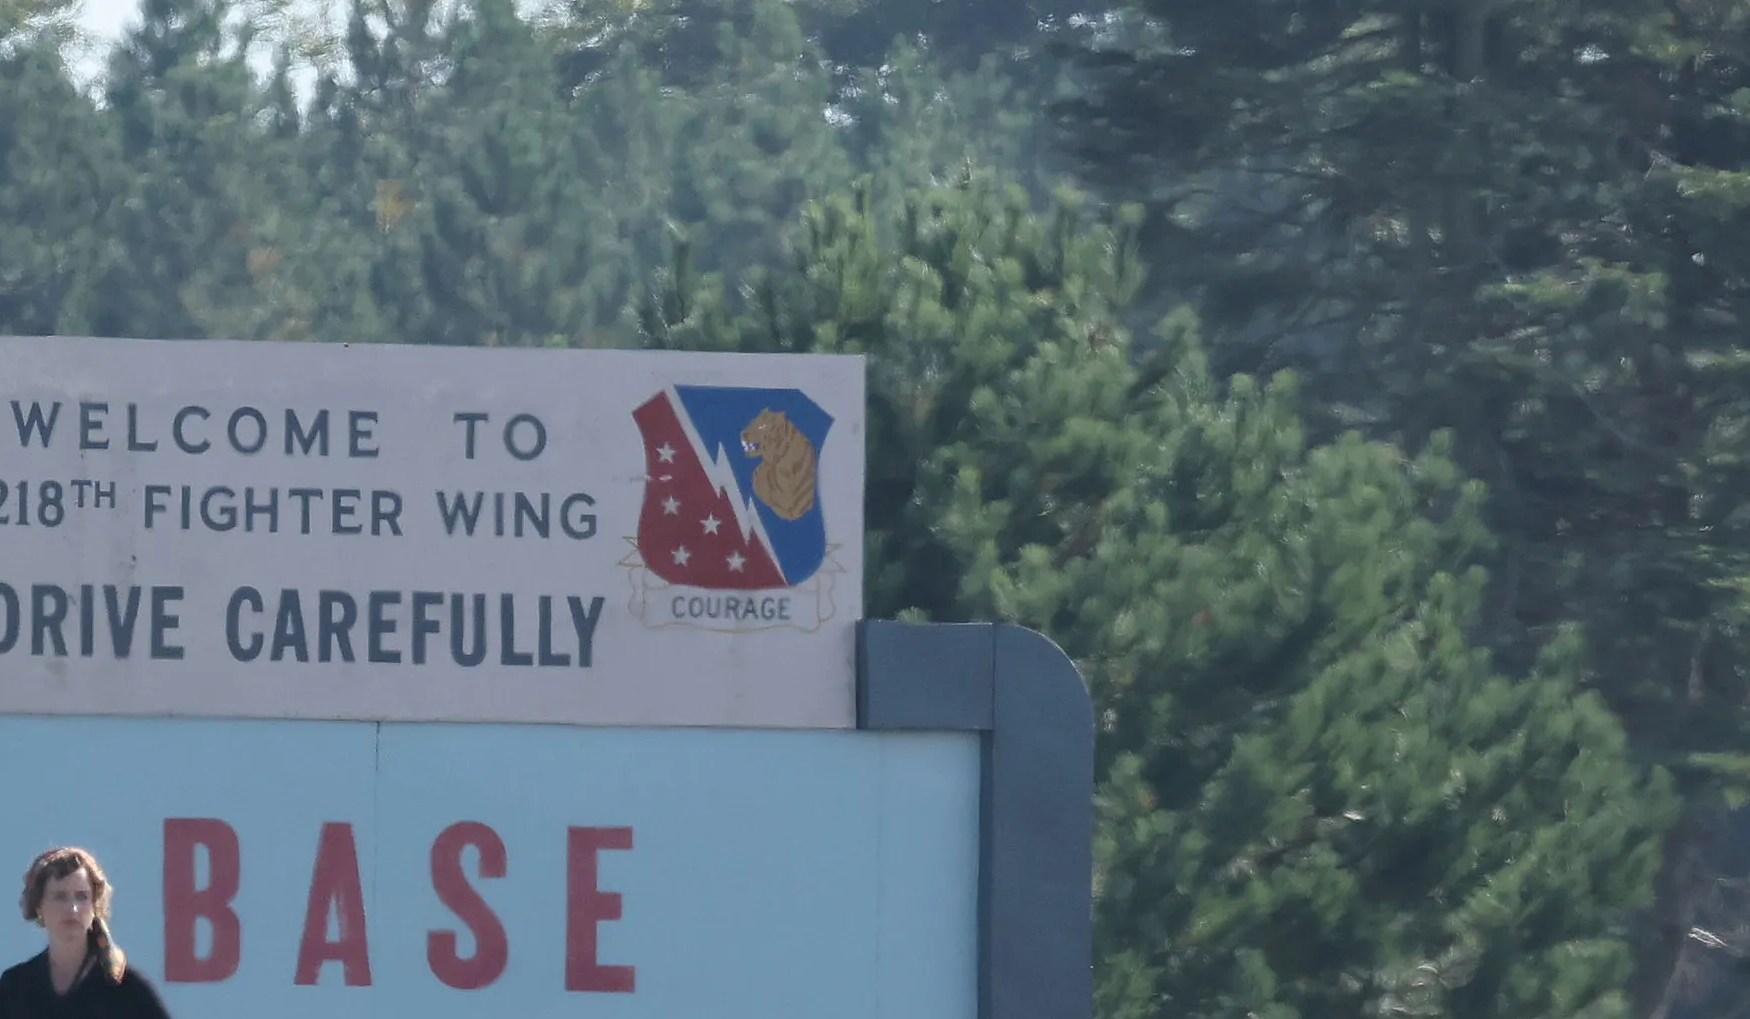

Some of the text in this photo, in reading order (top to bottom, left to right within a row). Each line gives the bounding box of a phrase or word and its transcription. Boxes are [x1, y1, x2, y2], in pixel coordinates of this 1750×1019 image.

[10, 399, 548, 462] WELCOME TO
[143, 484, 403, 537] FIGHTER
[435, 490, 597, 541] WING
[225, 585, 606, 669] CAREFULLY
[670, 595, 792, 621] COURAGE
[162, 816, 637, 994] BASE
